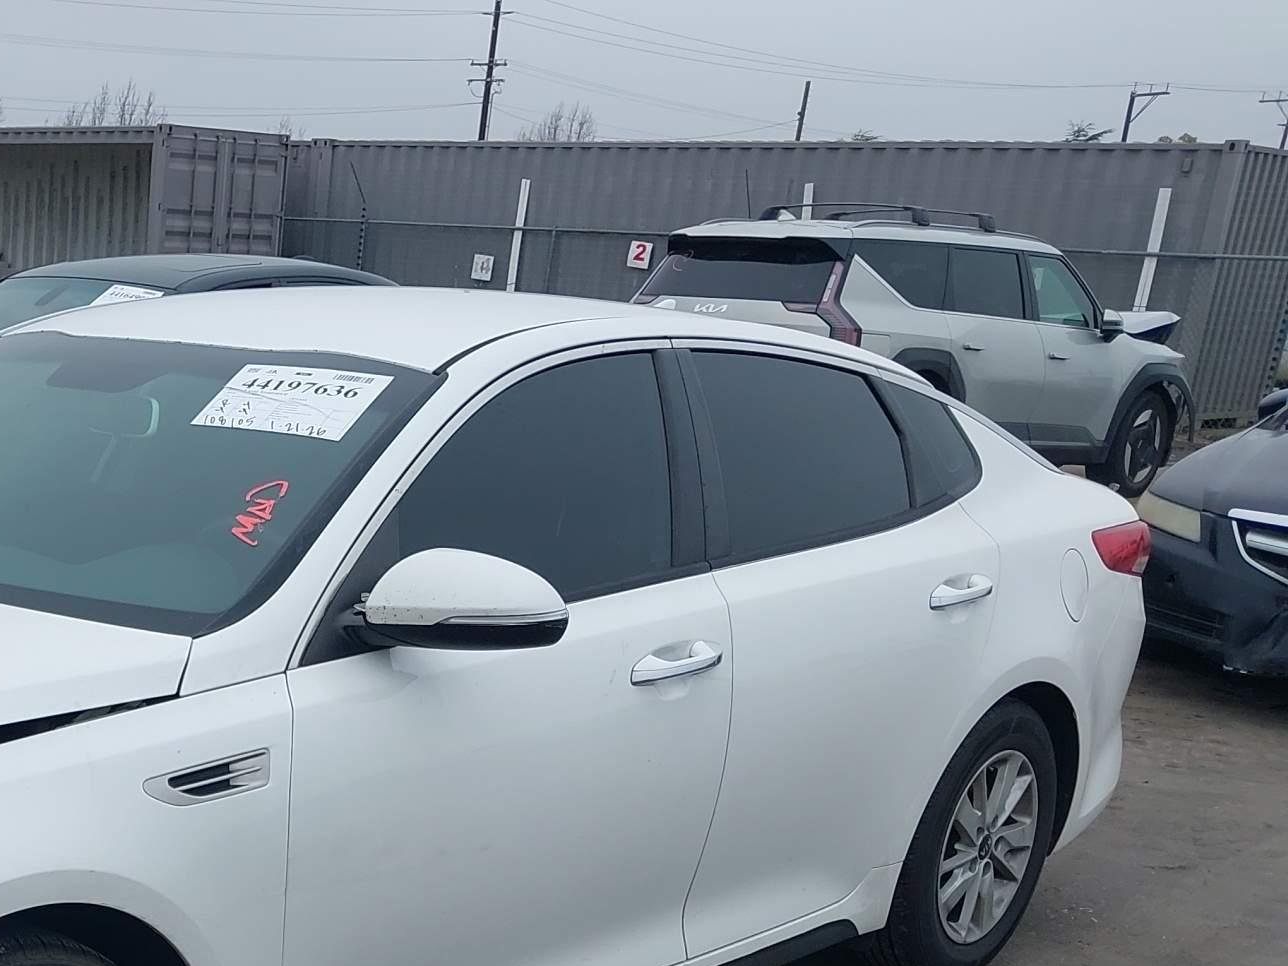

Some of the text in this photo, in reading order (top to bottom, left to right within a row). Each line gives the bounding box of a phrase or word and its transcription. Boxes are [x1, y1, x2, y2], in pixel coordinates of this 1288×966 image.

[633, 244, 647, 262] 2
[694, 303, 728, 313] KIA
[241, 377, 362, 399] 44197636
